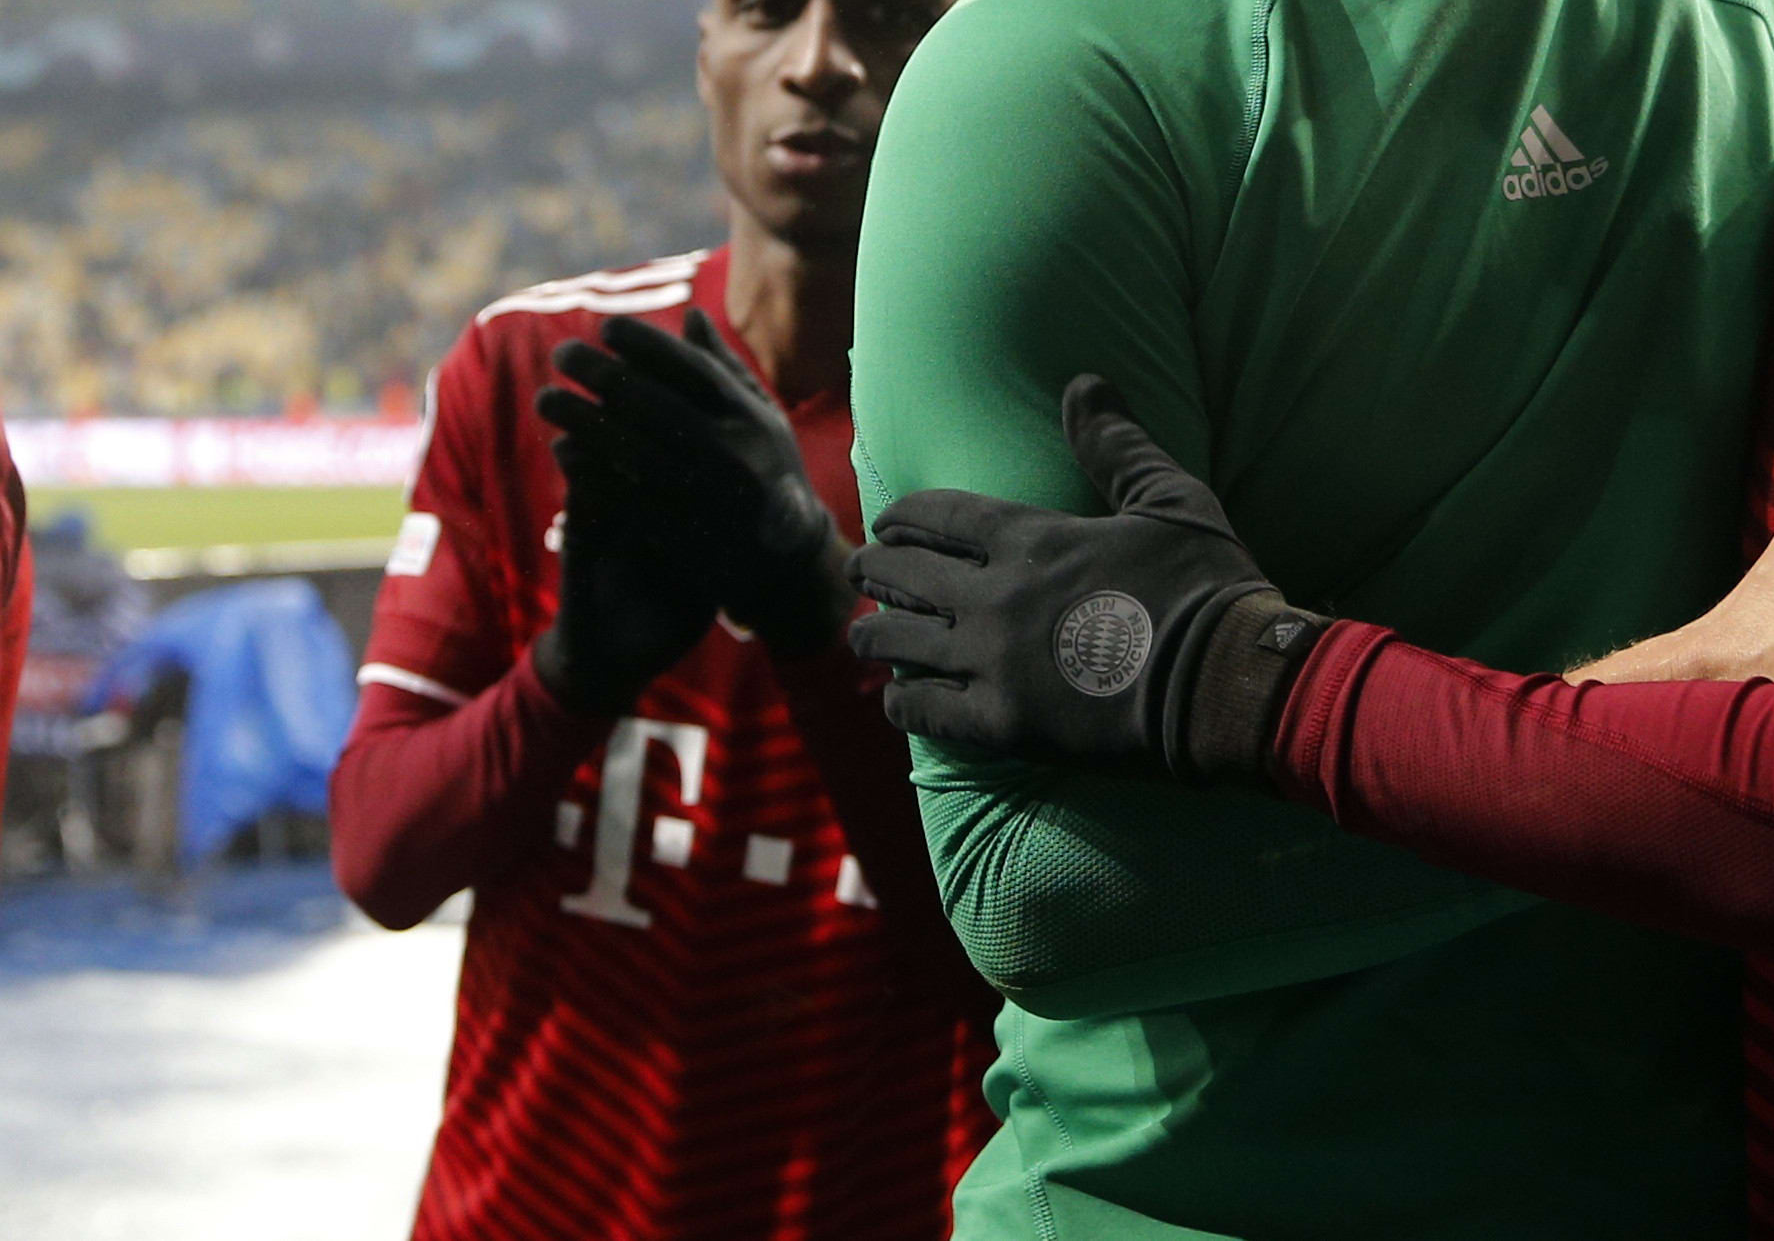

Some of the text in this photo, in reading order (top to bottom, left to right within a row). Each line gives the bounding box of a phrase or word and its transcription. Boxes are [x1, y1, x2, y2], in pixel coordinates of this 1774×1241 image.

[1503, 156, 1608, 200] adidas
[1062, 599, 1115, 678] FC BAYERN
